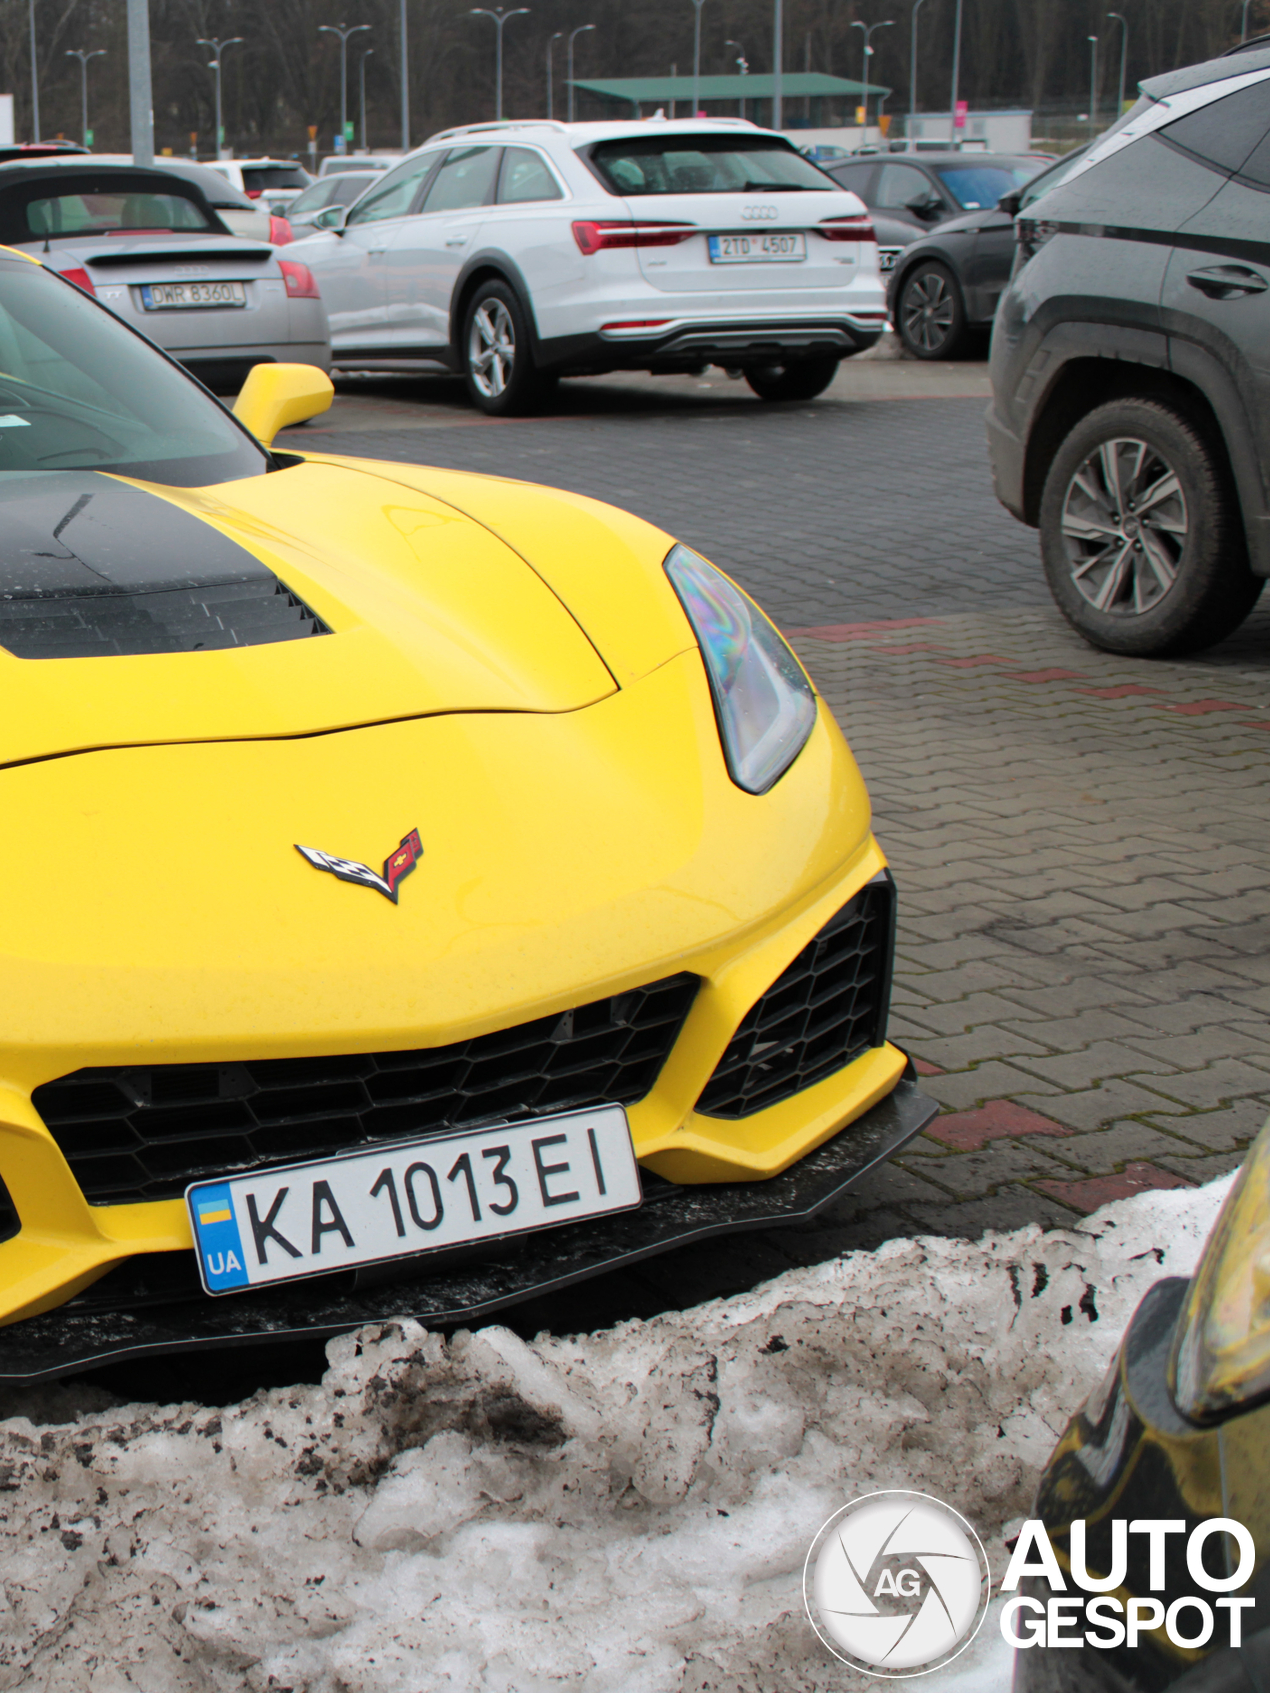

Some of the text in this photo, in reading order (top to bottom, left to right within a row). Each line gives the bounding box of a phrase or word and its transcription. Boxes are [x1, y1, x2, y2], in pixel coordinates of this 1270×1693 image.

[723, 236, 797, 255] 2TD 4507
[151, 284, 242, 304] DWR 8360L
[245, 1127, 608, 1265] KA 1013 EI
[207, 1249, 242, 1275] UA
